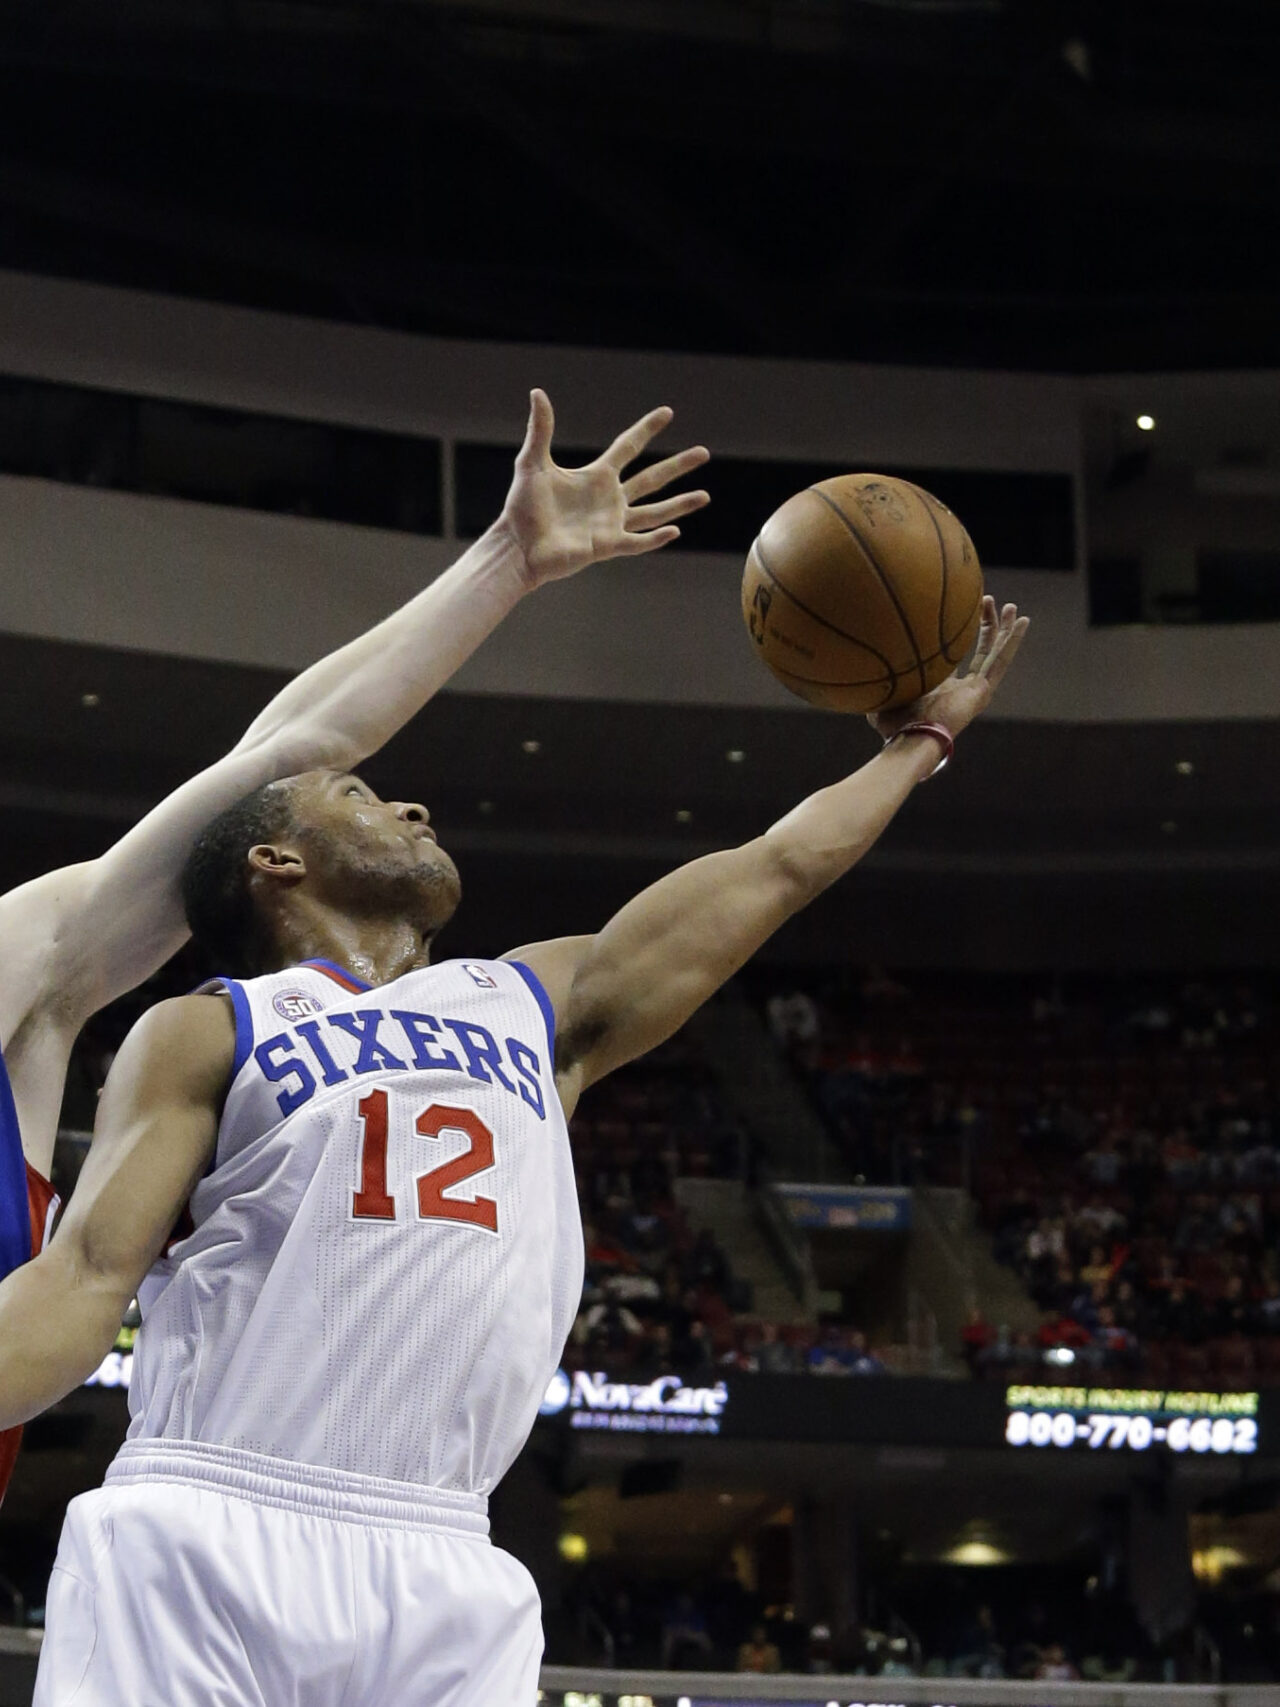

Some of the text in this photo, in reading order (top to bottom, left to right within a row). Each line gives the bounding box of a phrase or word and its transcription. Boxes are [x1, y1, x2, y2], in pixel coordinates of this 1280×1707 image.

[282, 998, 313, 1017] 50
[254, 1010, 547, 1121] SIXERS
[352, 1088, 500, 1234] 12
[571, 1370, 728, 1415] NovaCare
[1005, 1411, 1258, 1454] 800-770-6682
